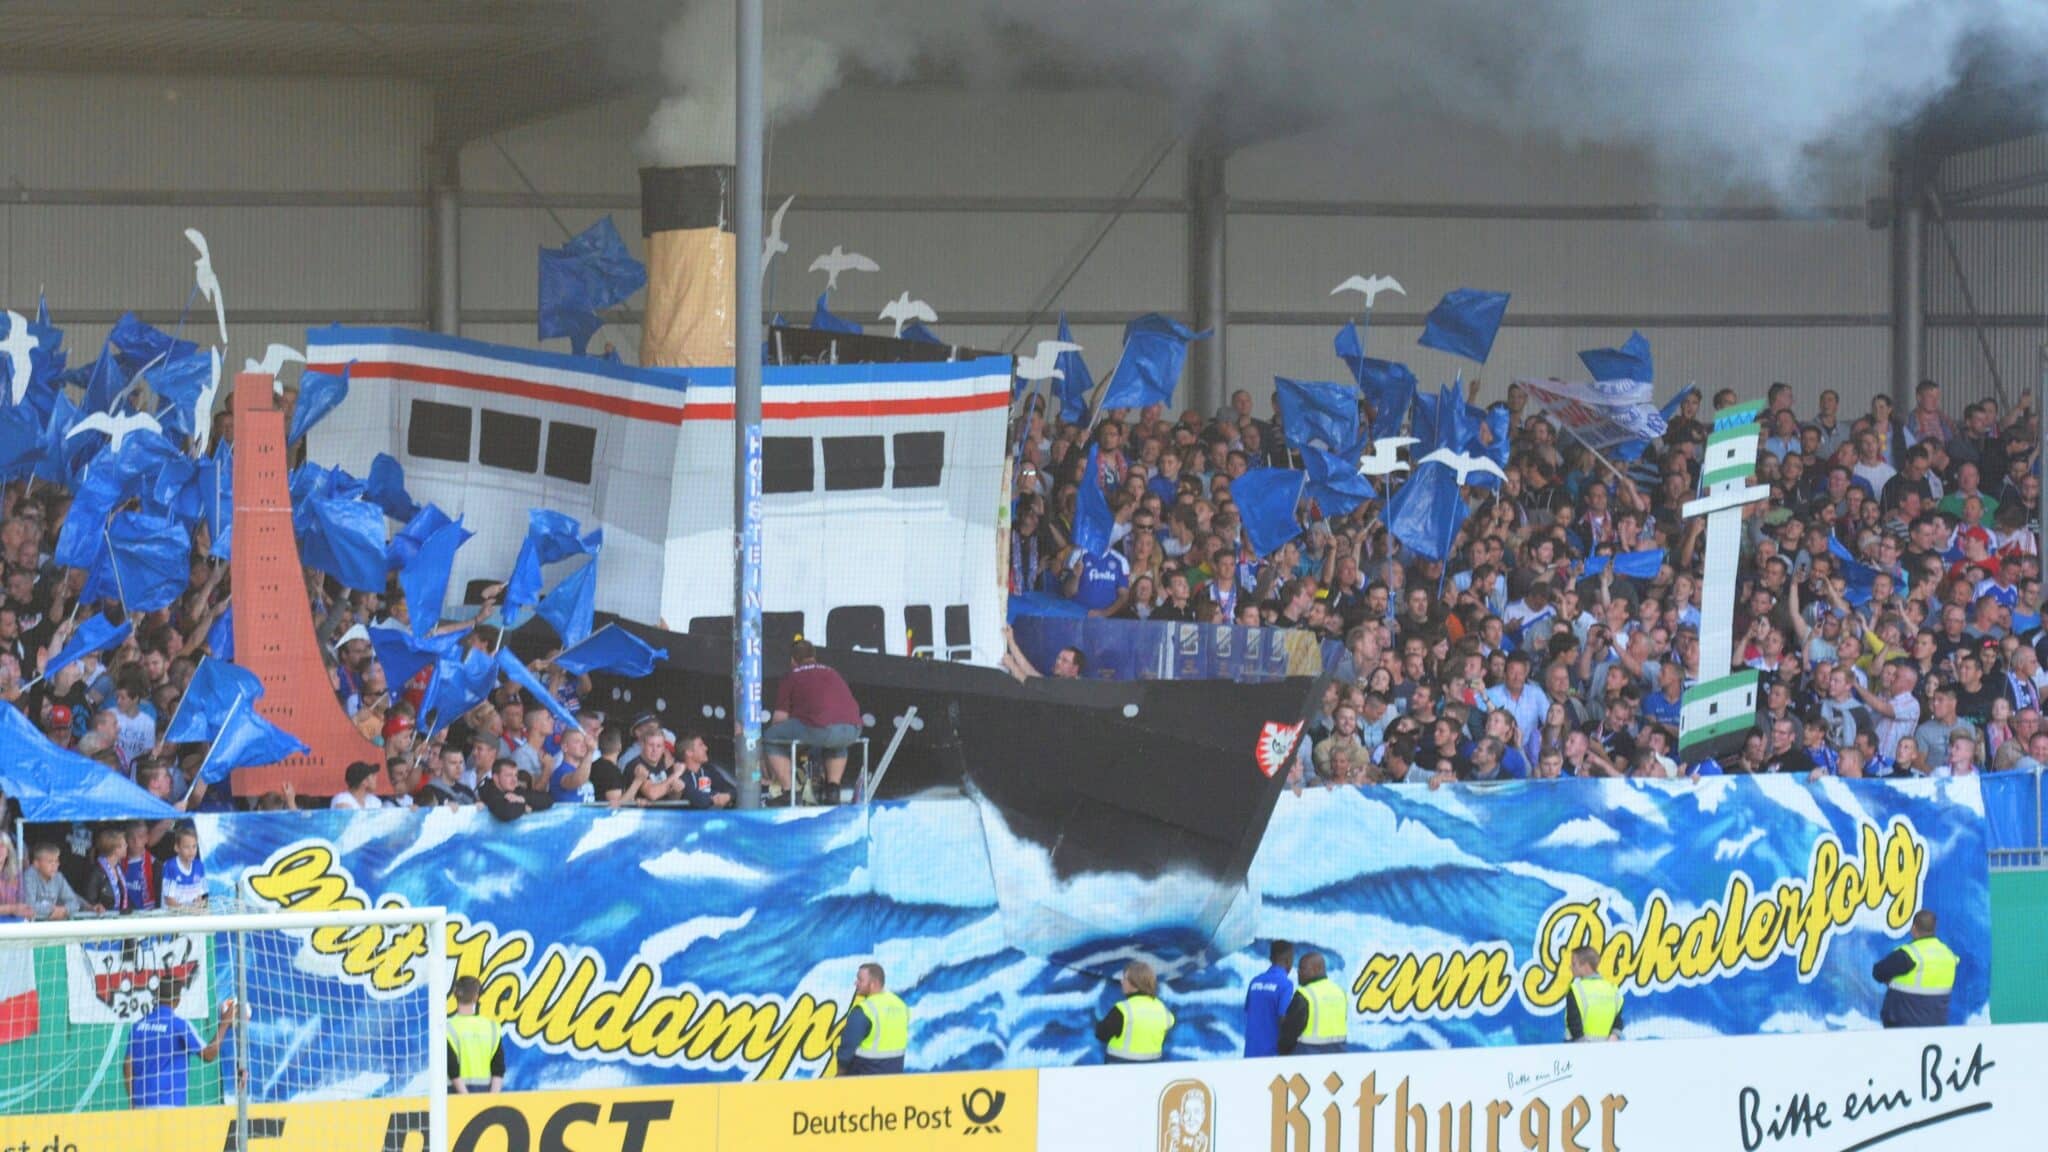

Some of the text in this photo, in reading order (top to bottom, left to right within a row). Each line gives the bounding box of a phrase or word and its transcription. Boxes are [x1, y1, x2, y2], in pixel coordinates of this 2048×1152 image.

[744, 435, 762, 723] HOLSTEIN KIEL
[1353, 947, 1513, 1013] zum
[792, 1105, 953, 1136] Deutsche Post
[1268, 1069, 1629, 1152] Bitburger
[1738, 1043, 1996, 1152] Bitte ein Bit
